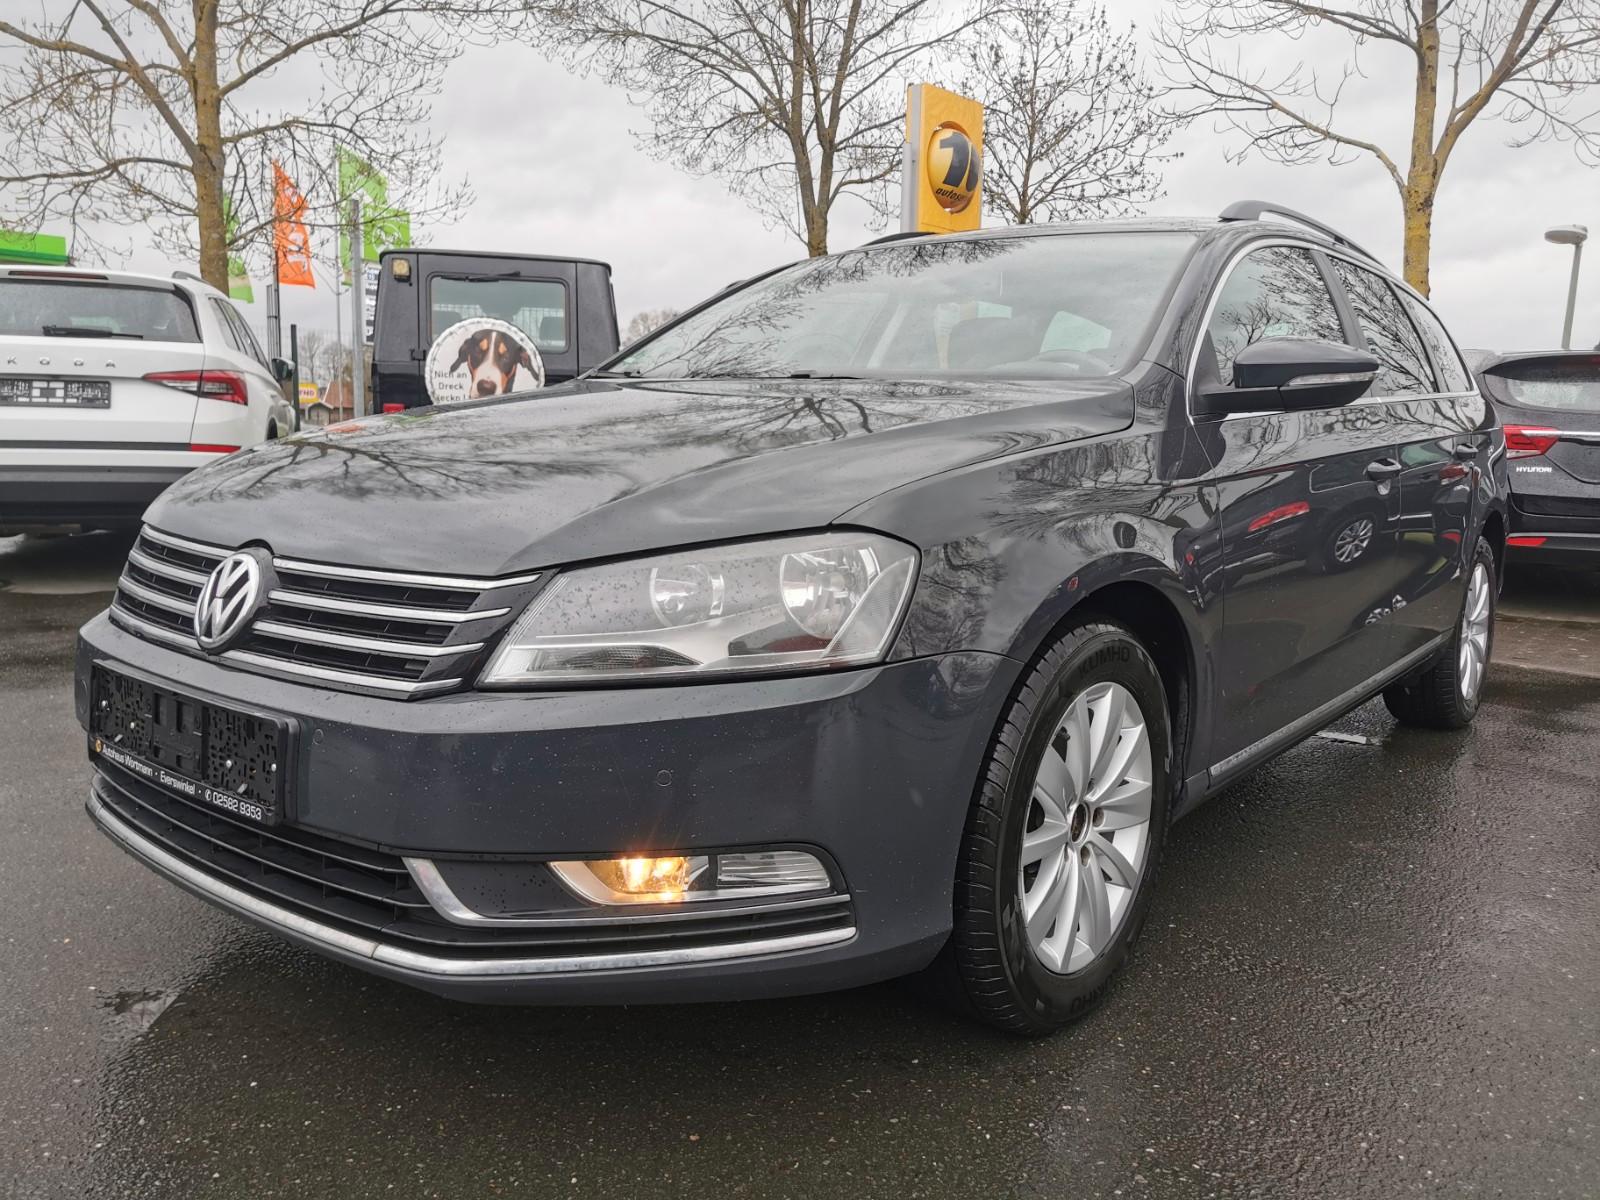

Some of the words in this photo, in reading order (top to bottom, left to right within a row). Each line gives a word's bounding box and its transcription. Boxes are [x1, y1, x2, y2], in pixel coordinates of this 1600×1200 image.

[438, 382, 464, 390] Dreck
[1078, 645, 1130, 677] KUMHO
[212, 792, 239, 812] 02582
[239, 802, 262, 820] 9353
